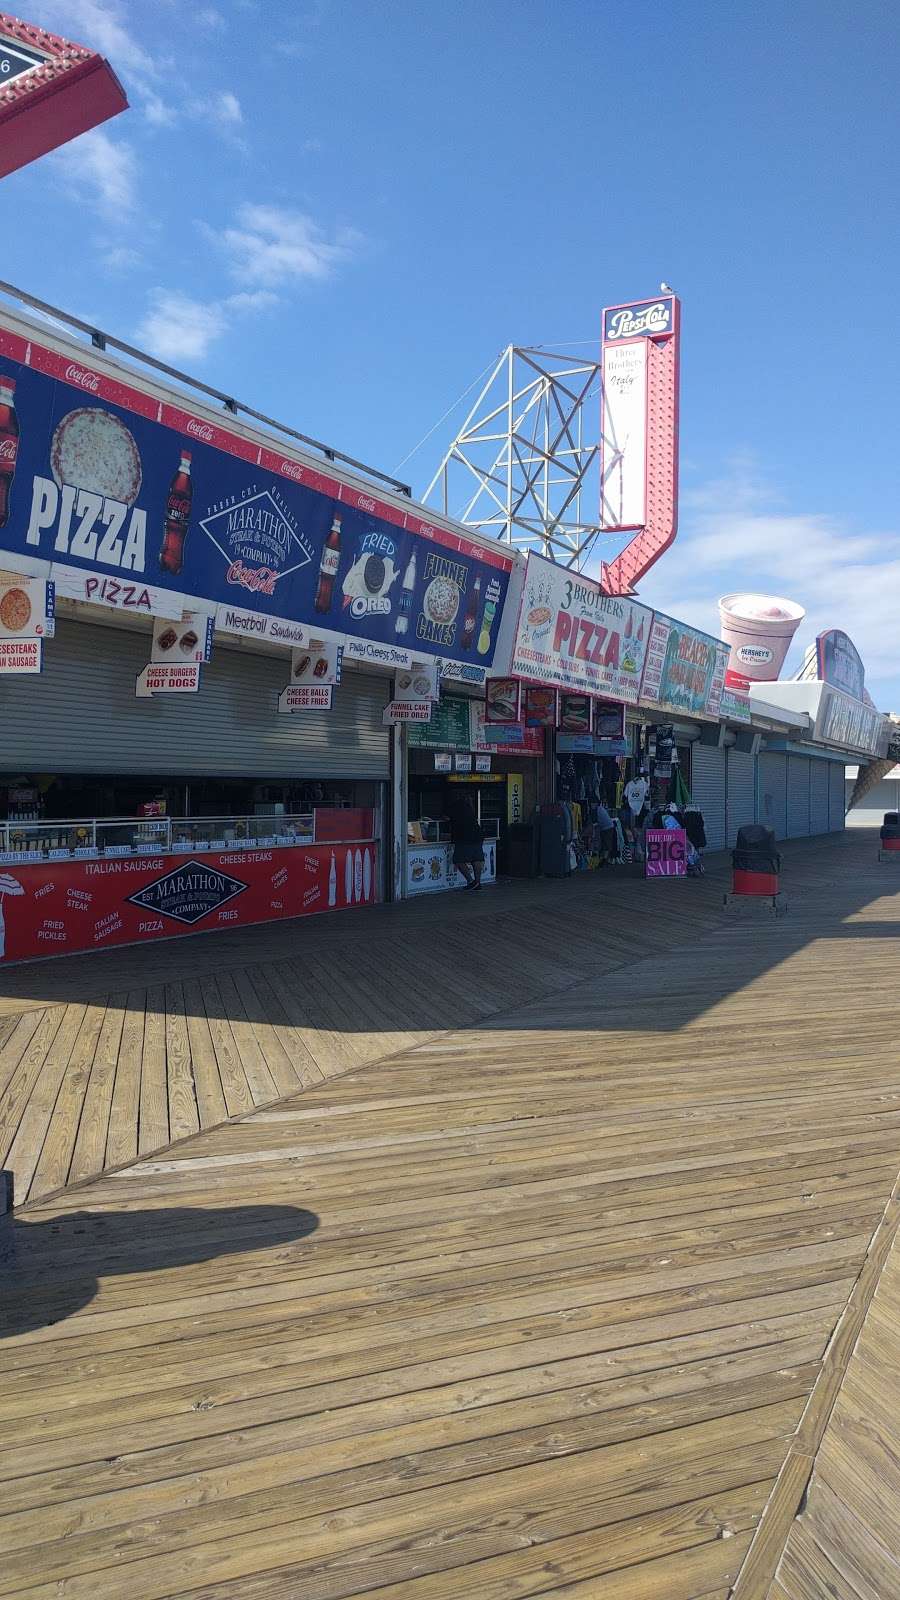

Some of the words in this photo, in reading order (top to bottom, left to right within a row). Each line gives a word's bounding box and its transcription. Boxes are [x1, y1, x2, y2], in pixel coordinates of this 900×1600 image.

[0, 59, 10, 73] 6
[608, 359, 642, 371] Brothers
[25, 475, 147, 573] PIZZA
[226, 507, 293, 555] MARATHON
[361, 532, 395, 555] FRIED
[424, 552, 469, 594] FUNNEL
[85, 577, 152, 610] PIZZA
[560, 580, 573, 610] 3
[573, 583, 625, 620] BROTHERS
[350, 596, 392, 620] OREO
[225, 611, 267, 634] Meatball
[270, 622, 304, 643] Sandwich
[416, 612, 457, 647] CAKES
[553, 610, 621, 671] PIZZA
[349, 642, 366, 657] Philly
[367, 644, 390, 661] Cheese
[390, 649, 409, 665] Steak
[740, 648, 770, 659] HERSHEY'S
[8, 656, 37, 668] SAUSAGE
[147, 668, 169, 678] CHEESE
[170, 667, 197, 677] BURGERS
[146, 679, 167, 688] HOT
[169, 678, 196, 688] DOGS
[286, 688, 310, 697] CHEESE
[311, 688, 329, 697] BALLS
[286, 697, 310, 706] CHEESE
[311, 697, 329, 706] FRIES
[390, 702, 413, 711] FUNNEL
[415, 703, 429, 711] CAKE
[390, 711, 409, 719] FRIED
[411, 711, 429, 719] OREO
[647, 841, 685, 861] BIG
[219, 854, 247, 866] CHEESE
[247, 852, 273, 864] STEAKS
[85, 862, 122, 876] ITALIAN
[123, 859, 165, 874] SAUSAGE
[647, 860, 686, 876] SALE
[33, 882, 57, 900] FRIES
[156, 874, 225, 900] MARATHON
[66, 888, 93, 902] CHEESE
[142, 893, 153, 902] EST
[66, 899, 88, 911] STEAK
[173, 903, 210, 916] COMPANY
[94, 911, 120, 930] ITALIAN
[218, 910, 239, 921] FRIES
[43, 919, 65, 931] FRIED
[94, 919, 124, 943] SAUSAGE
[138, 920, 164, 933] PIZZA
[38, 930, 67, 942] PICKLES
